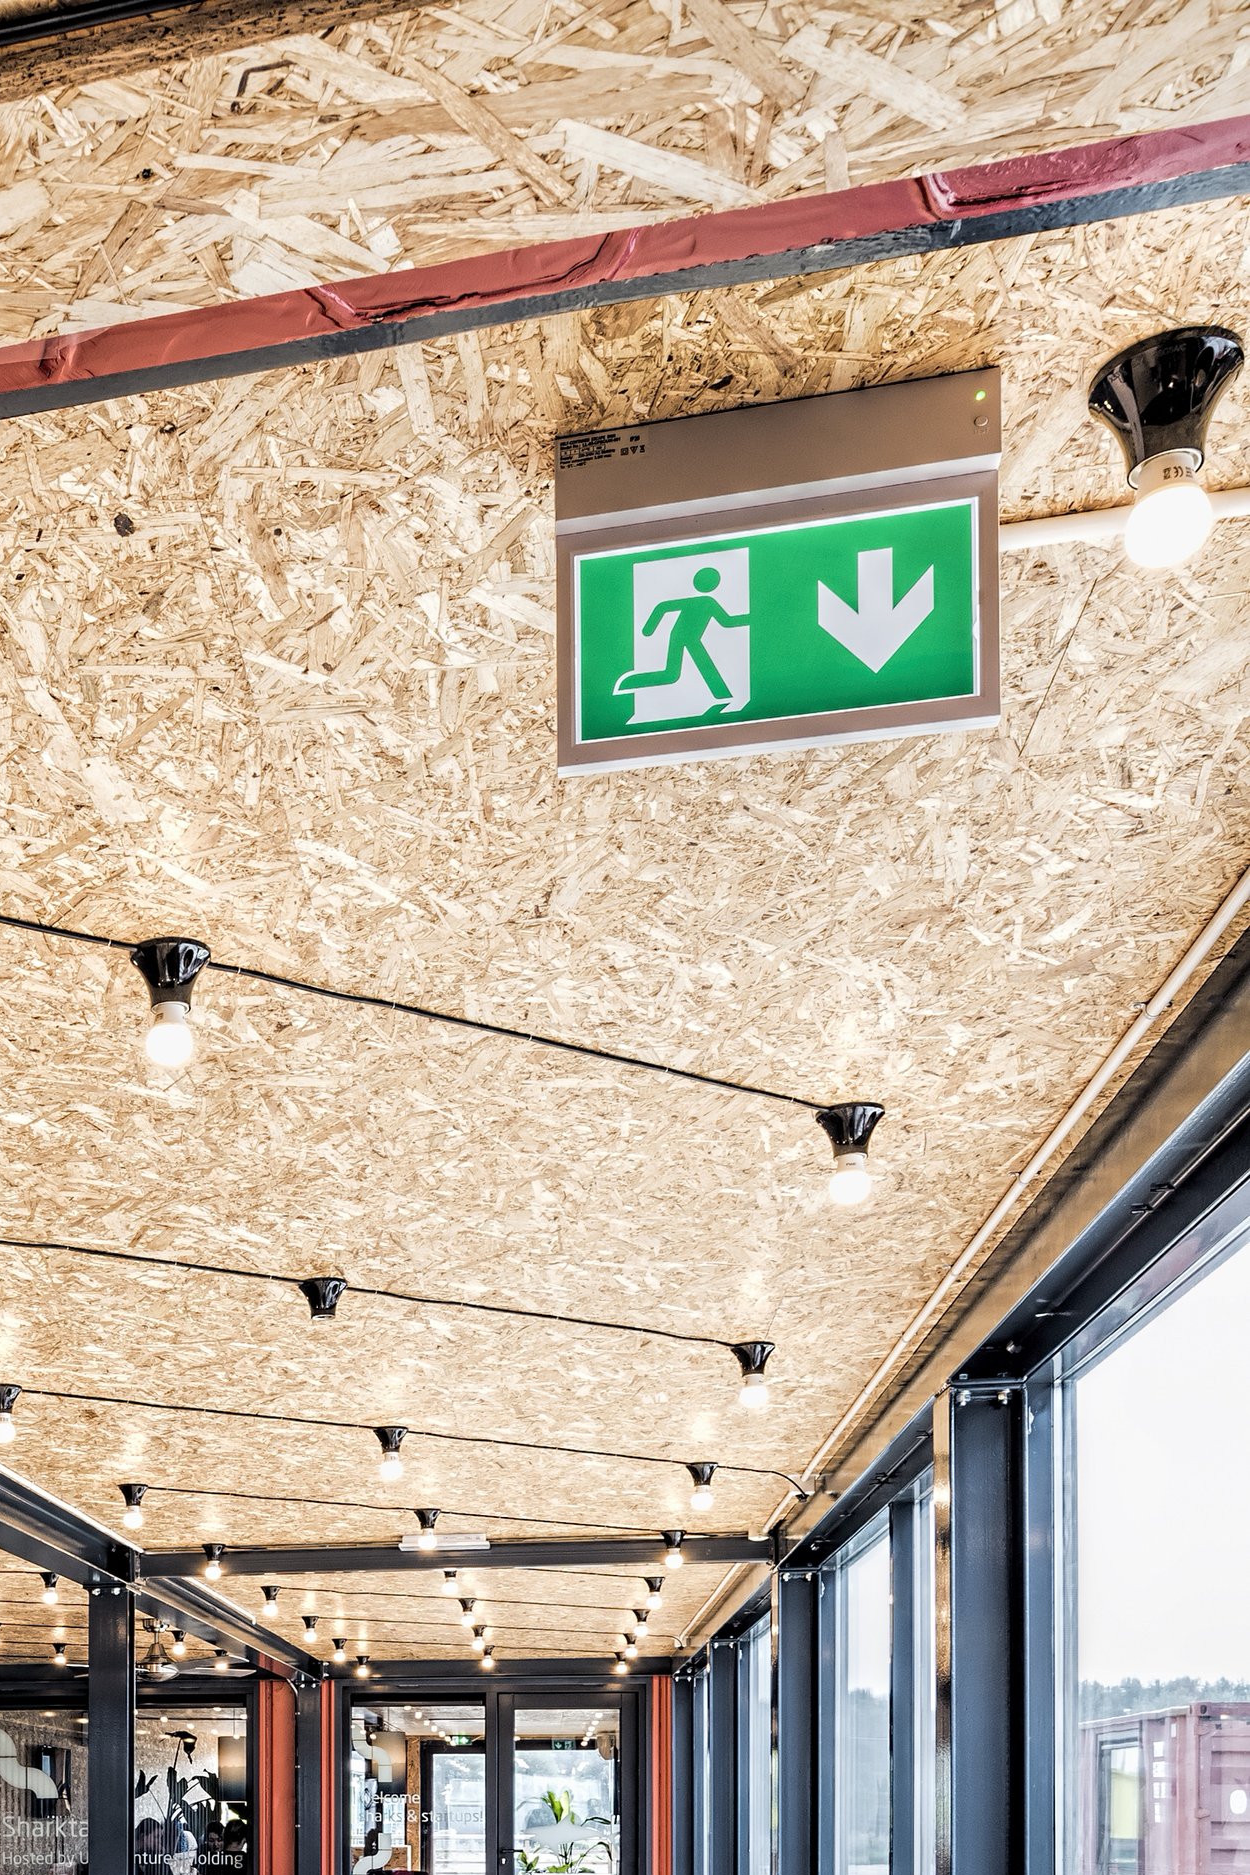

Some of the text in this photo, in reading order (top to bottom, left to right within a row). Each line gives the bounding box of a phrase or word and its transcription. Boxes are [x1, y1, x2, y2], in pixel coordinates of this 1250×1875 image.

[365, 1790, 421, 1804] elcome
[407, 1809, 418, 1823] &
[2, 1815, 89, 1838] Sharkta
[2, 1851, 54, 1865] Hosted
[58, 1850, 75, 1868] by
